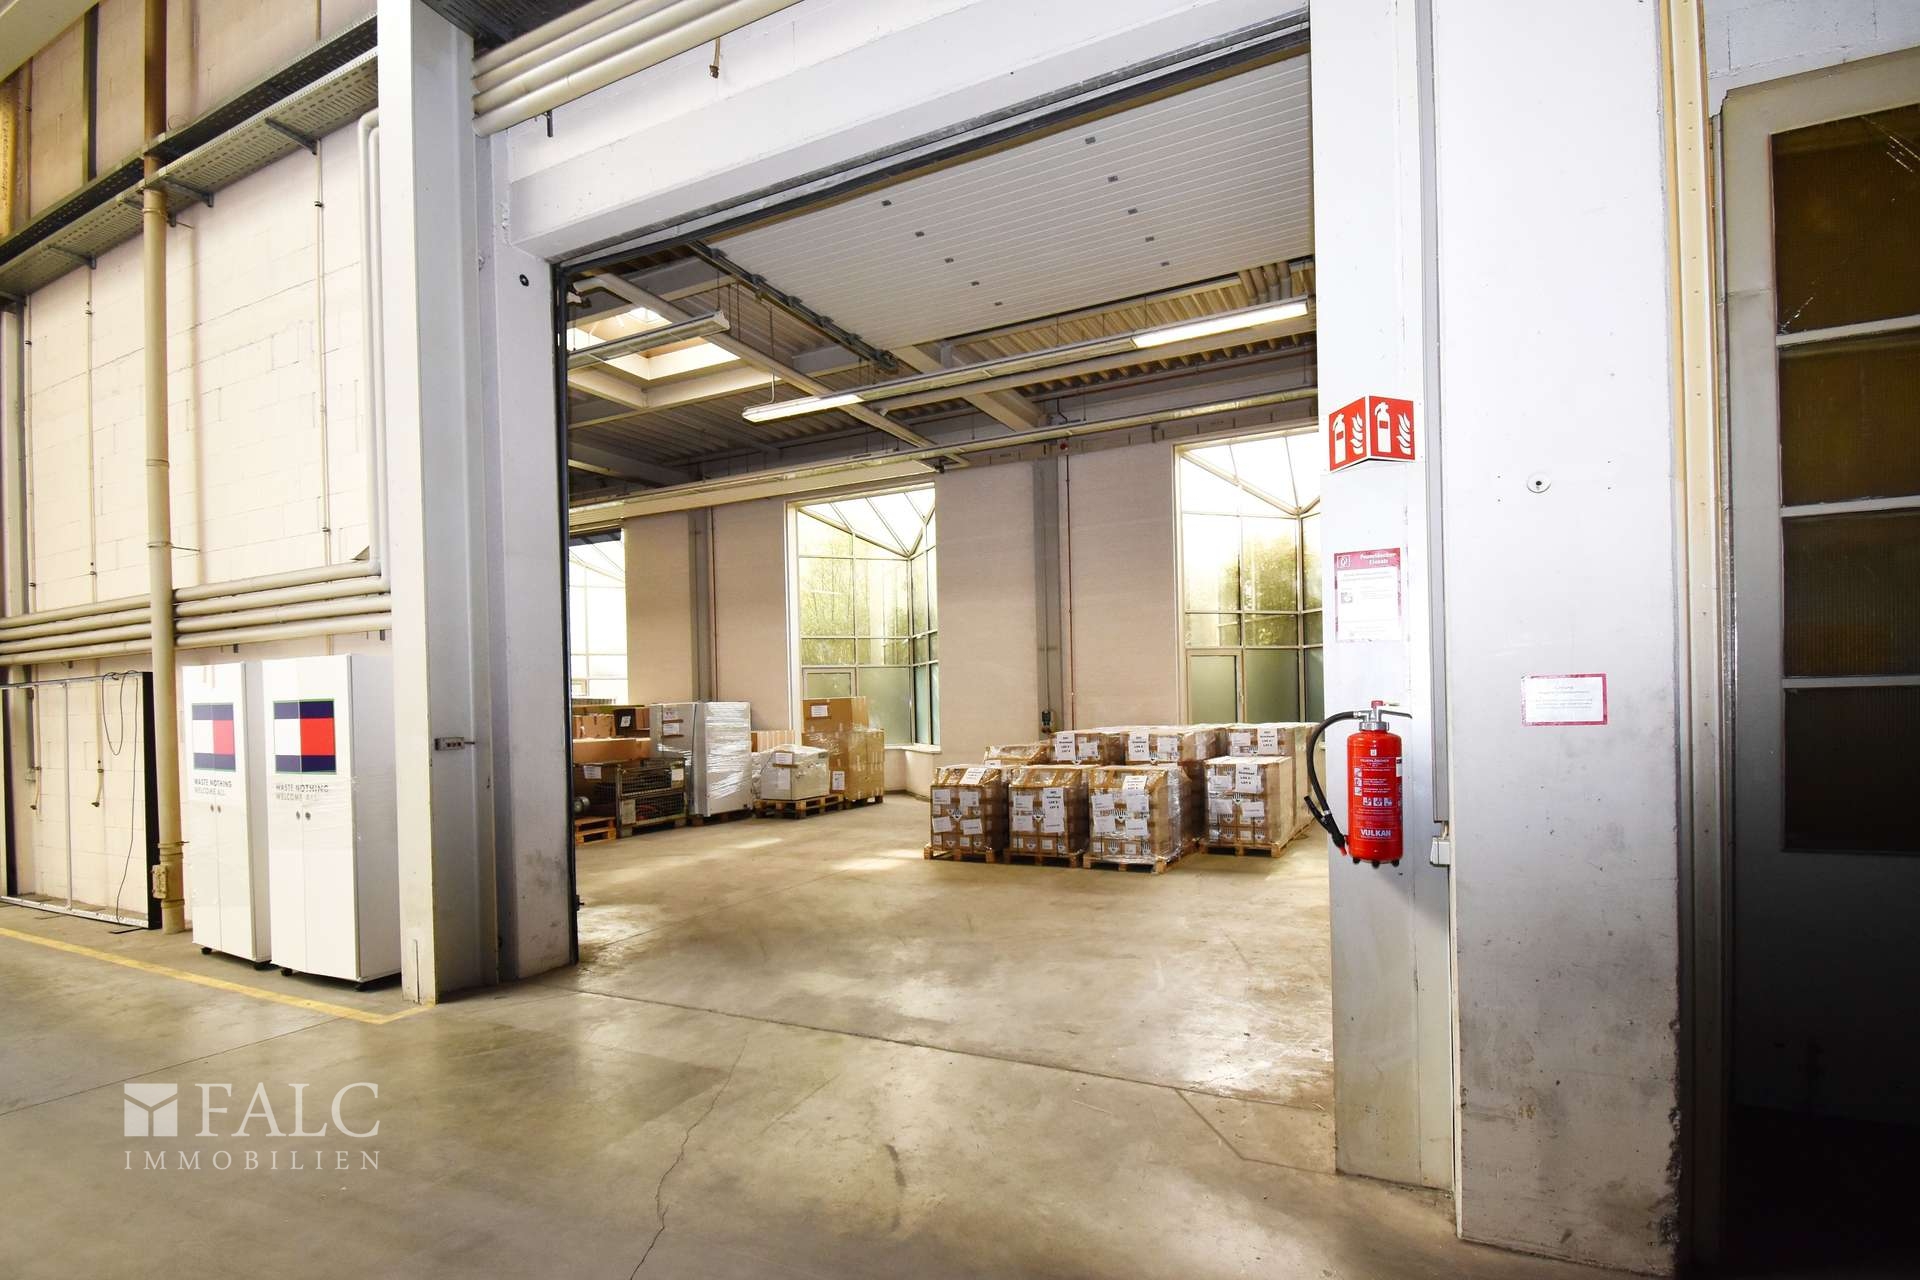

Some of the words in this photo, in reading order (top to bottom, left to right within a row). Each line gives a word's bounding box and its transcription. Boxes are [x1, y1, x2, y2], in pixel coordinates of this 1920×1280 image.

[194, 778, 209, 786] WASTE
[210, 779, 232, 788] NOTHING
[275, 783, 293, 792] WASTE
[295, 784, 329, 793] NOTHING
[1360, 828, 1392, 837] VULKAN
